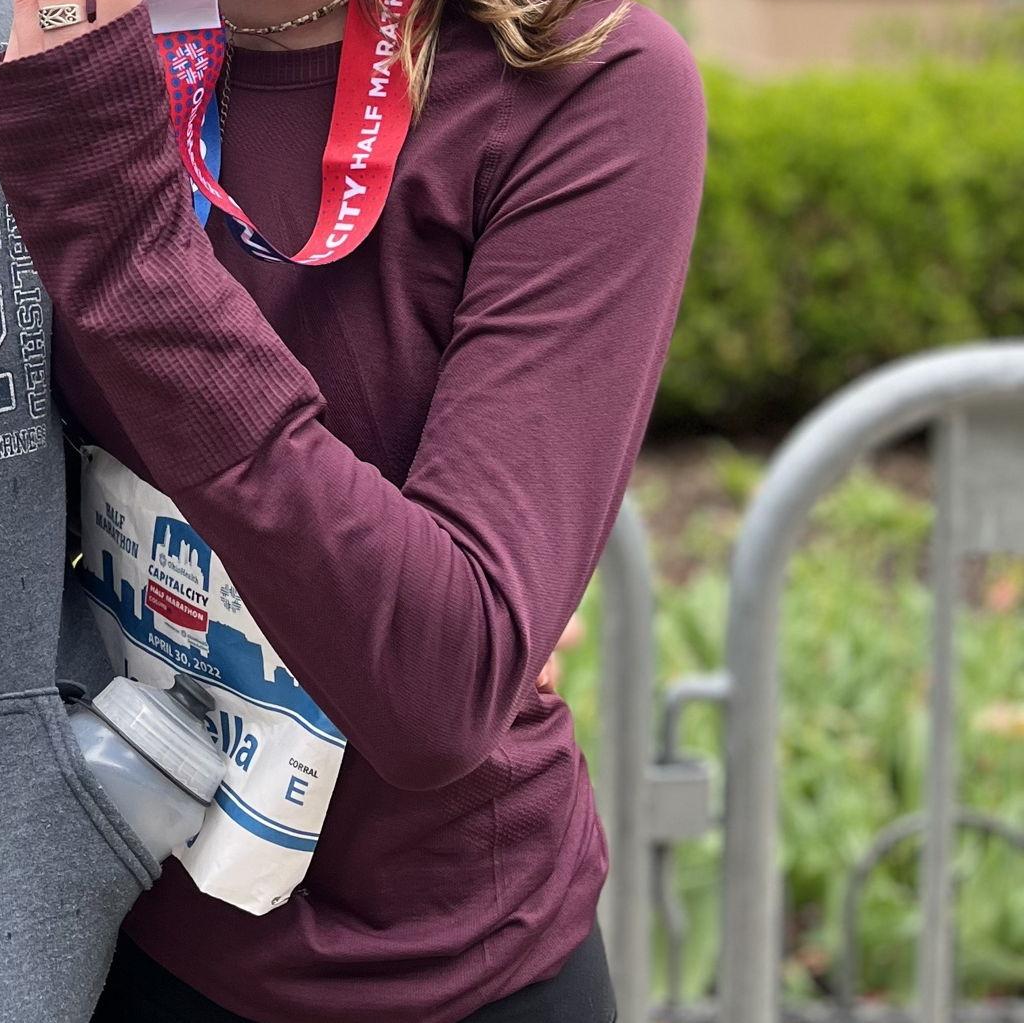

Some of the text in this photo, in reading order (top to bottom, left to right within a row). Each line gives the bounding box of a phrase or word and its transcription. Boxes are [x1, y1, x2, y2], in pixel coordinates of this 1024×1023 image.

[326, 175, 367, 250] CITY
[350, 104, 383, 170] HALF
[95, 510, 139, 559] MARATHON
[165, 593, 205, 622] MARATHON
[148, 632, 173, 657] APRIL
[174, 649, 192, 668] 30,
[193, 657, 222, 679] 2022
[288, 757, 319, 779] CORRAL
[284, 774, 309, 807] E
